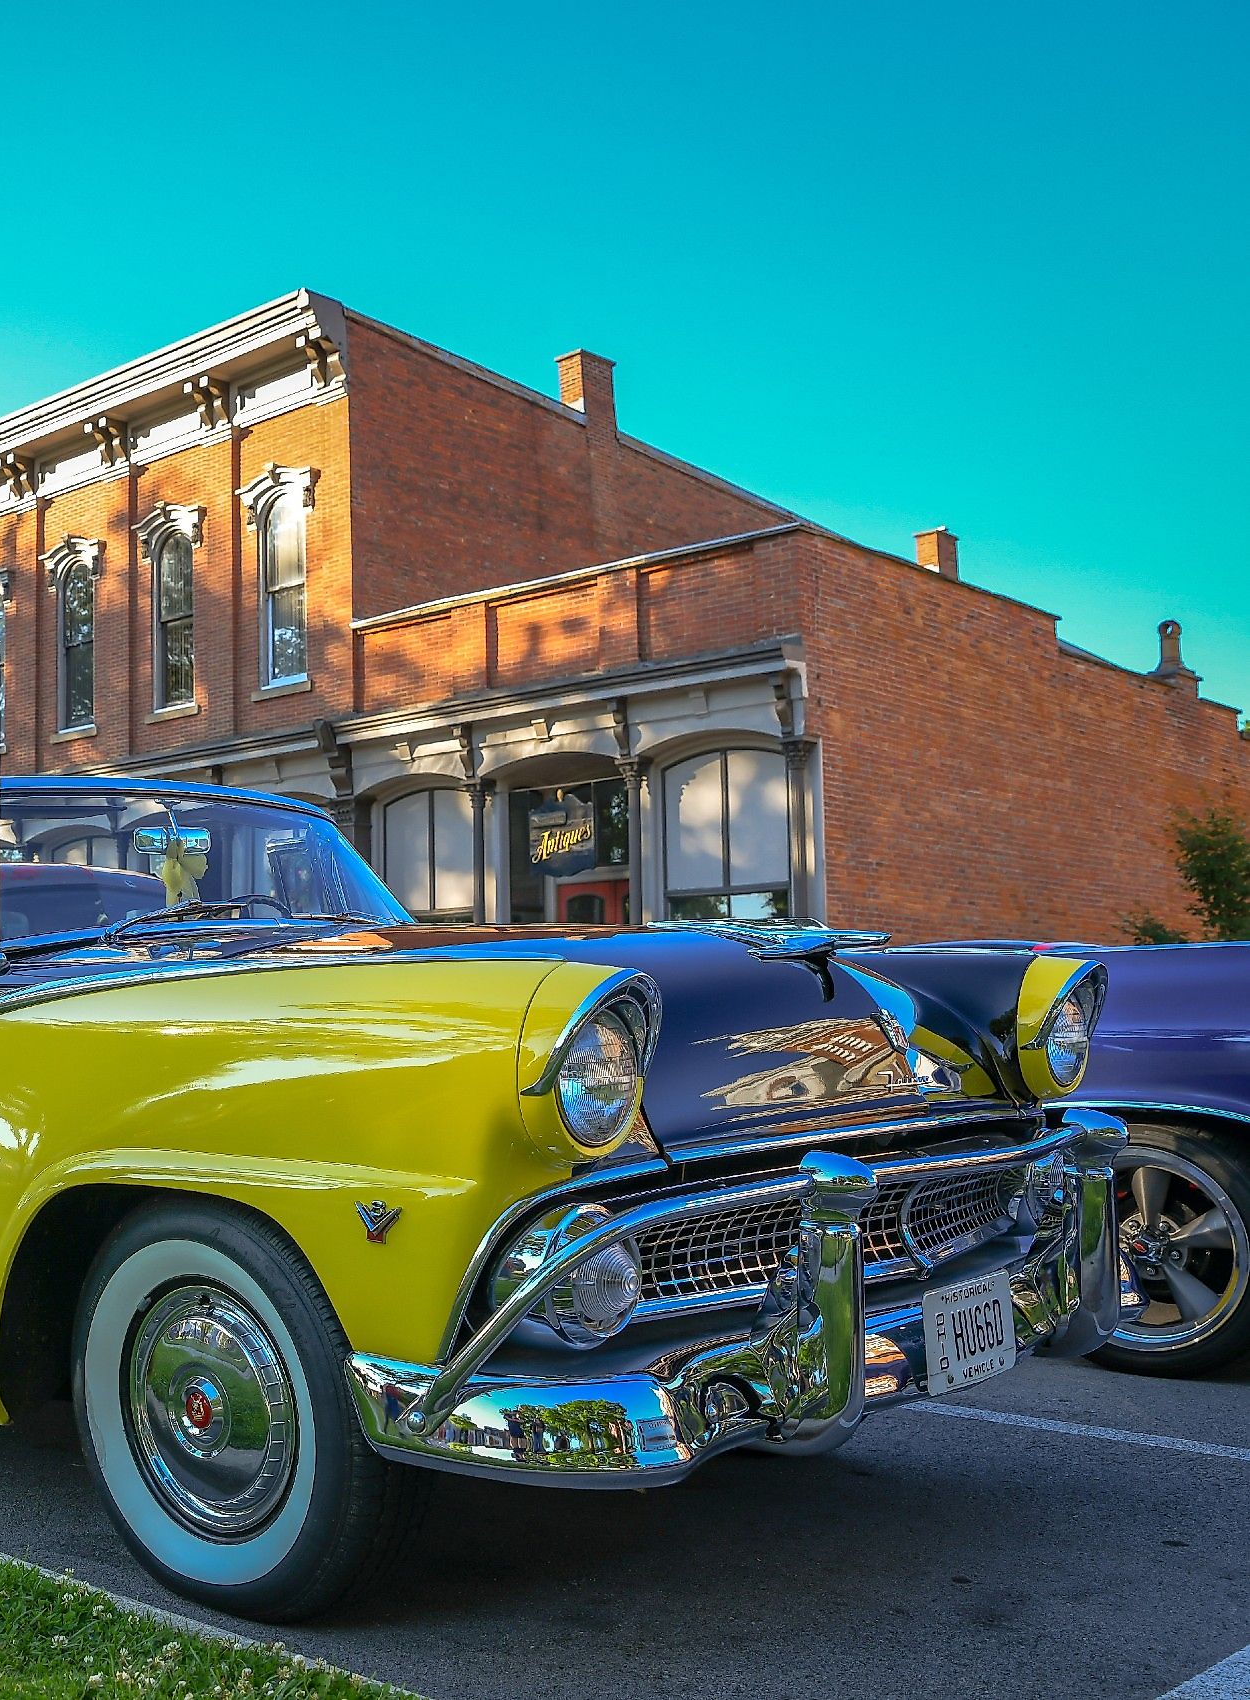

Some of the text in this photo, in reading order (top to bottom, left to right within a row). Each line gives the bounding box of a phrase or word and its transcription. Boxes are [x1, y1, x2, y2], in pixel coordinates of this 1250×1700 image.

[531, 823, 591, 864] Antiques
[945, 1282, 992, 1304] HISTORICAL
[935, 1312, 950, 1371] OHIO
[962, 1359, 995, 1379] VEHICLE
